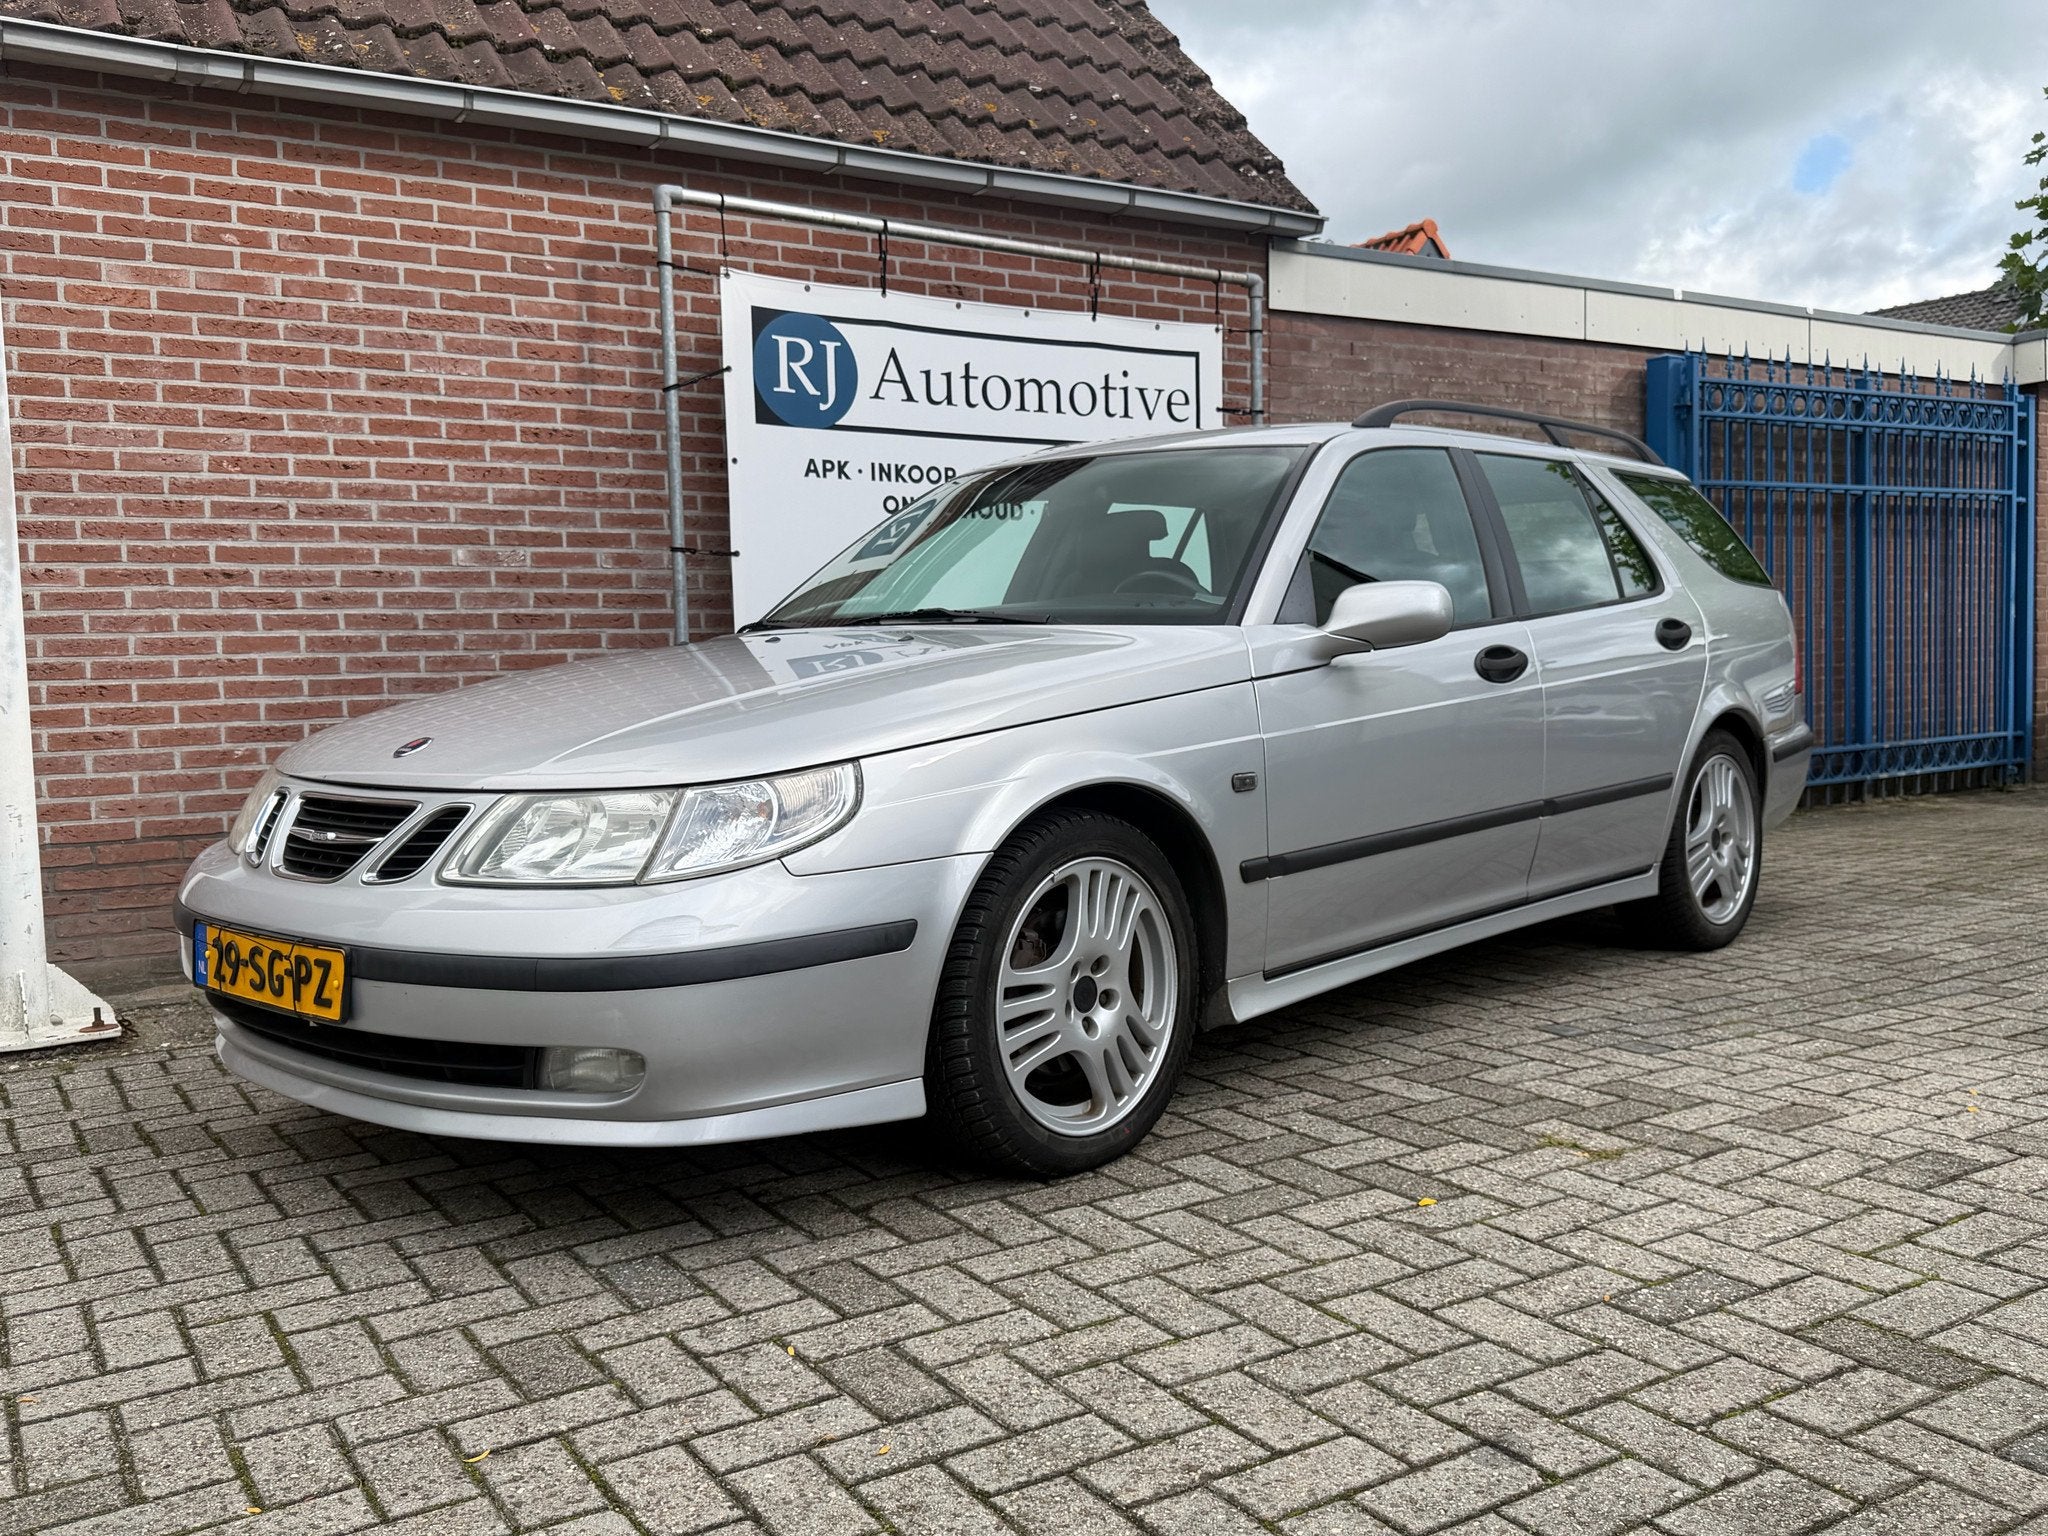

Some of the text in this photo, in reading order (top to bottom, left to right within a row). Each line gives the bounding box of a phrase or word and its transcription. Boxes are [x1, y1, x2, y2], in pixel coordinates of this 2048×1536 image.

[771, 334, 1191, 423] RJ Automotive
[804, 458, 957, 485] APK INKOOP
[212, 936, 333, 1009] 29-SG-PZ
